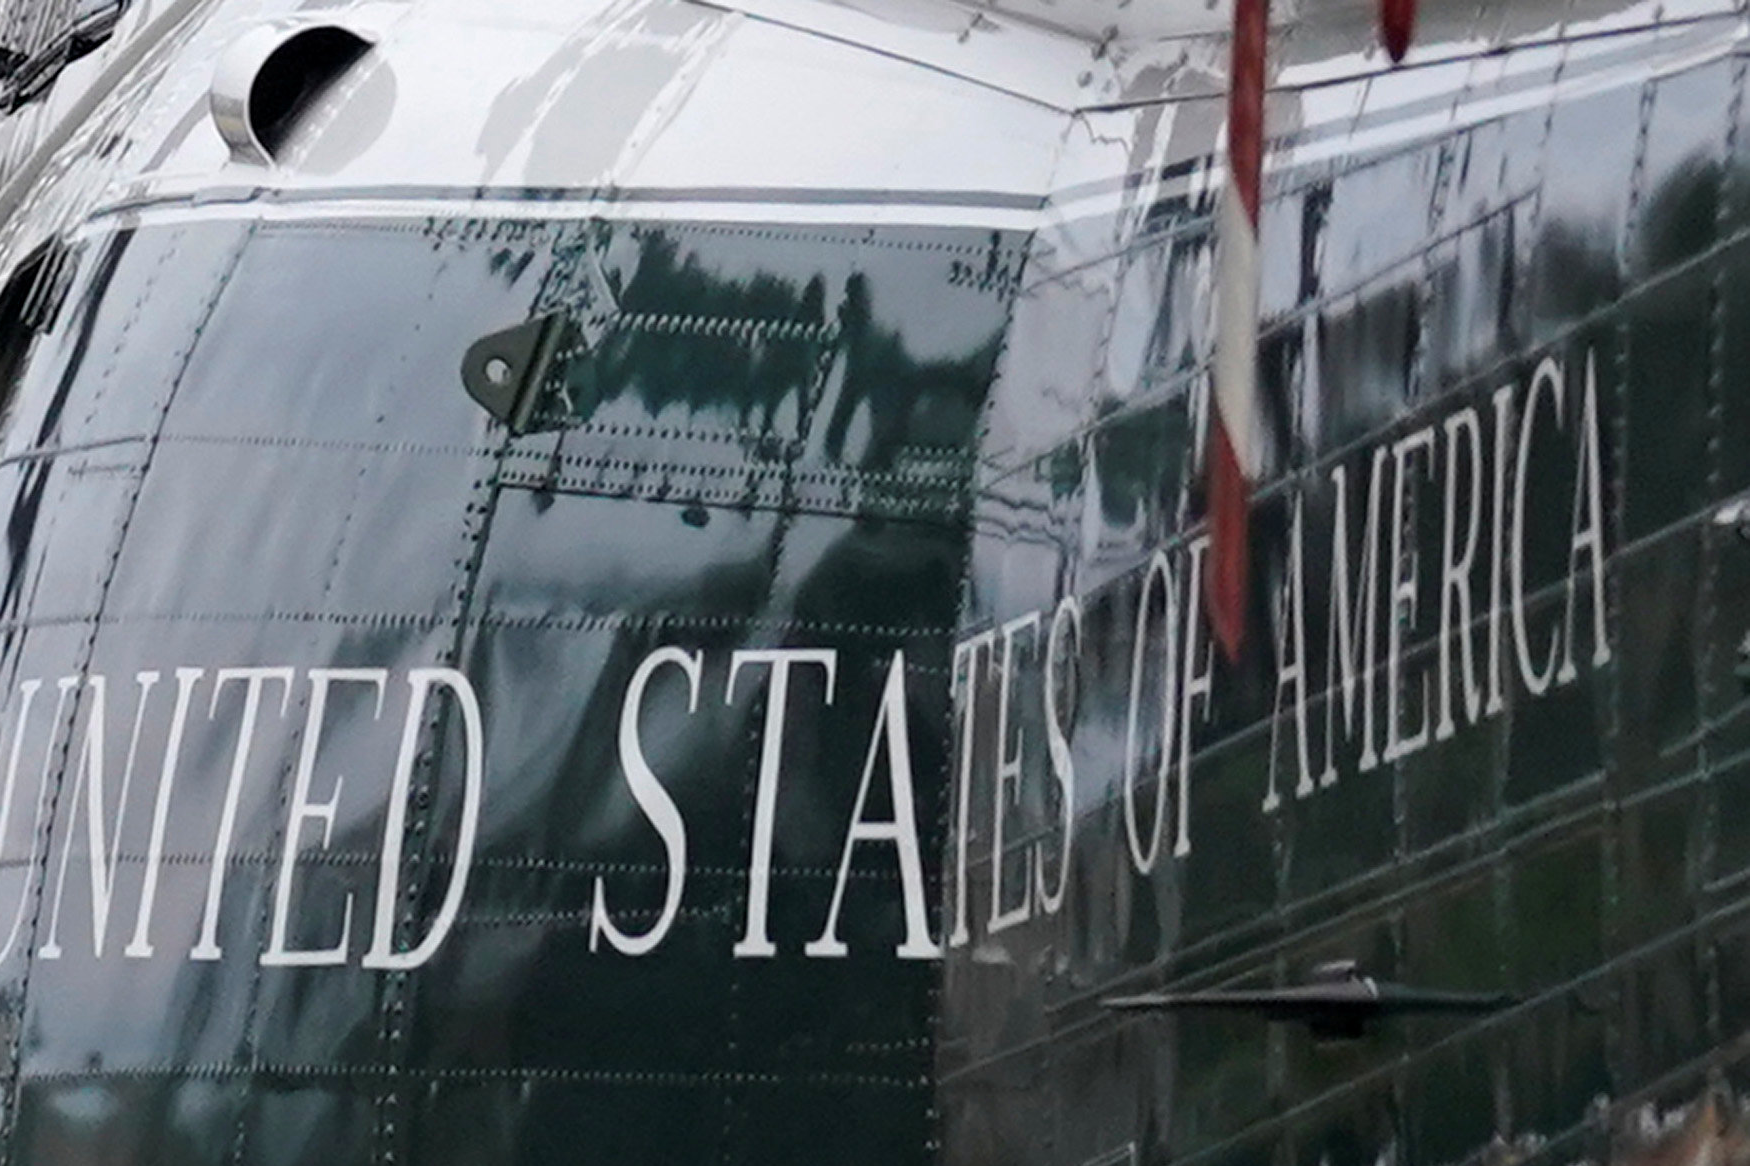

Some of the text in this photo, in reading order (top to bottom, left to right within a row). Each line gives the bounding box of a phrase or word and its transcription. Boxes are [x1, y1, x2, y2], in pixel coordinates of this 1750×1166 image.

[590, 597, 1081, 958] STATES
[1124, 535, 1216, 875] OF
[1262, 347, 1611, 813] AMERICA
